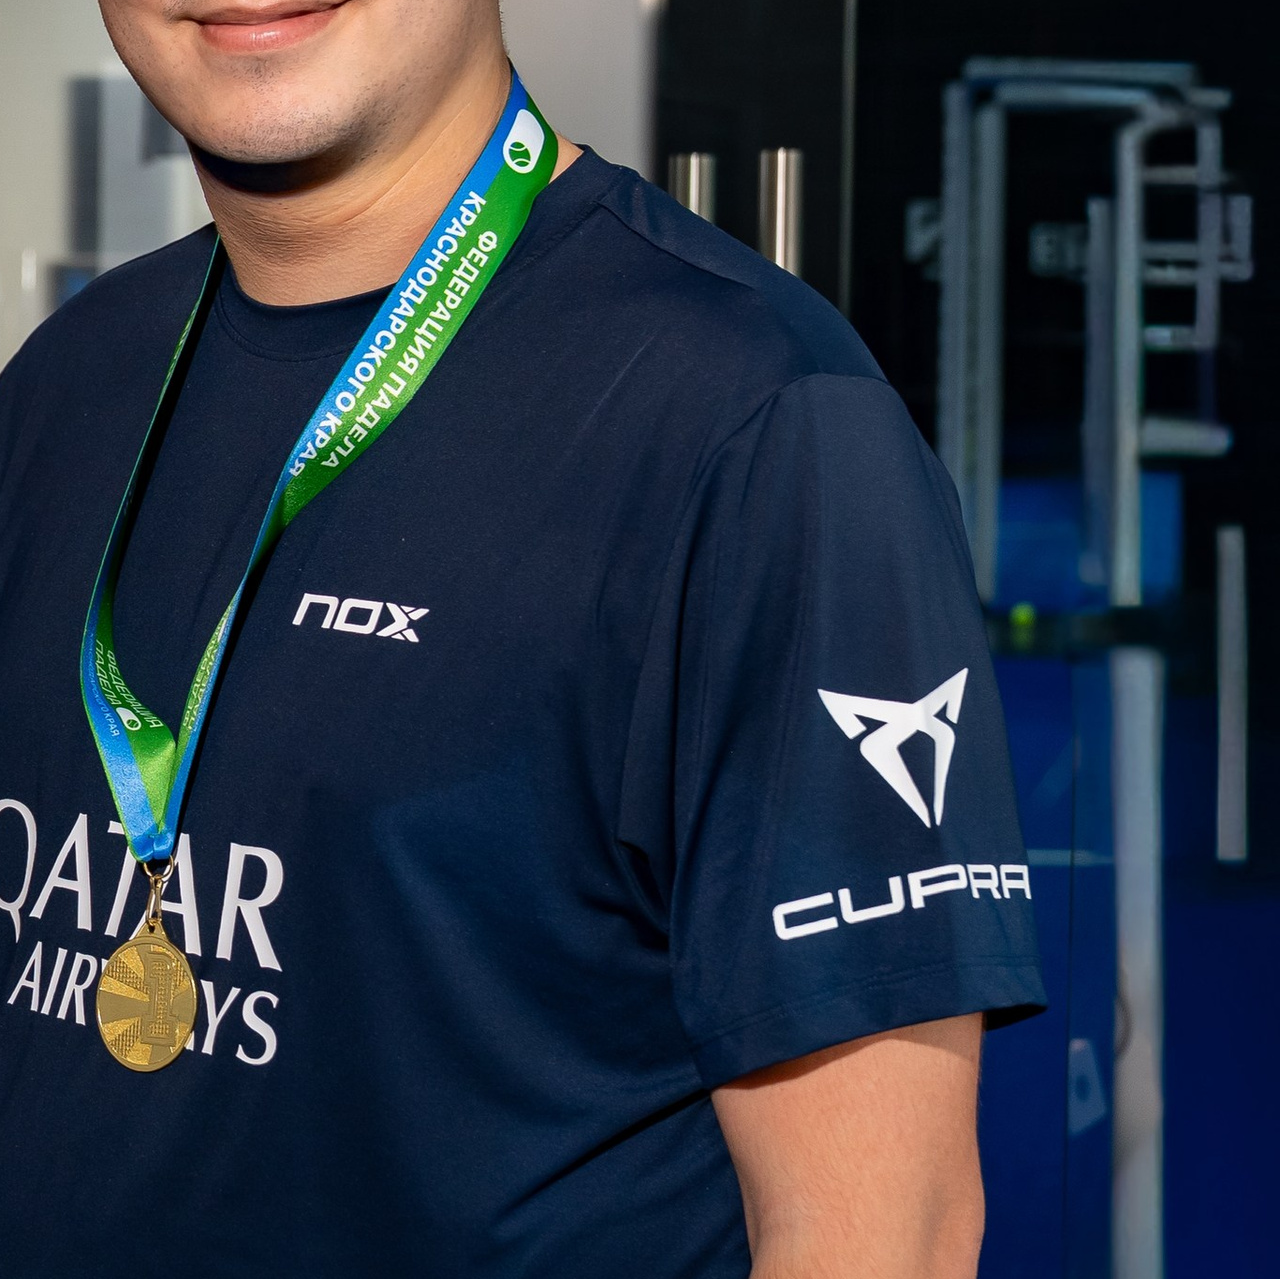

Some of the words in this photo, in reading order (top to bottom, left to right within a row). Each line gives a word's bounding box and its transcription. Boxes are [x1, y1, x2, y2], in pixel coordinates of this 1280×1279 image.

[335, 190, 488, 414] КРАСНОДАРСКОГО
[396, 230, 498, 375] ФЕДЕРАЦИЯ
[288, 415, 343, 478] КРАЯ
[321, 377, 407, 469] ПАДЕЛА
[95, 639, 122, 706] ПАДЕЛА
[106, 650, 164, 728] ФЕДЕРАЦИЯ
[103, 712, 121, 737] КРАЯ
[772, 863, 1032, 941] CUPRA
[7, 941, 280, 1066] AIRYS
